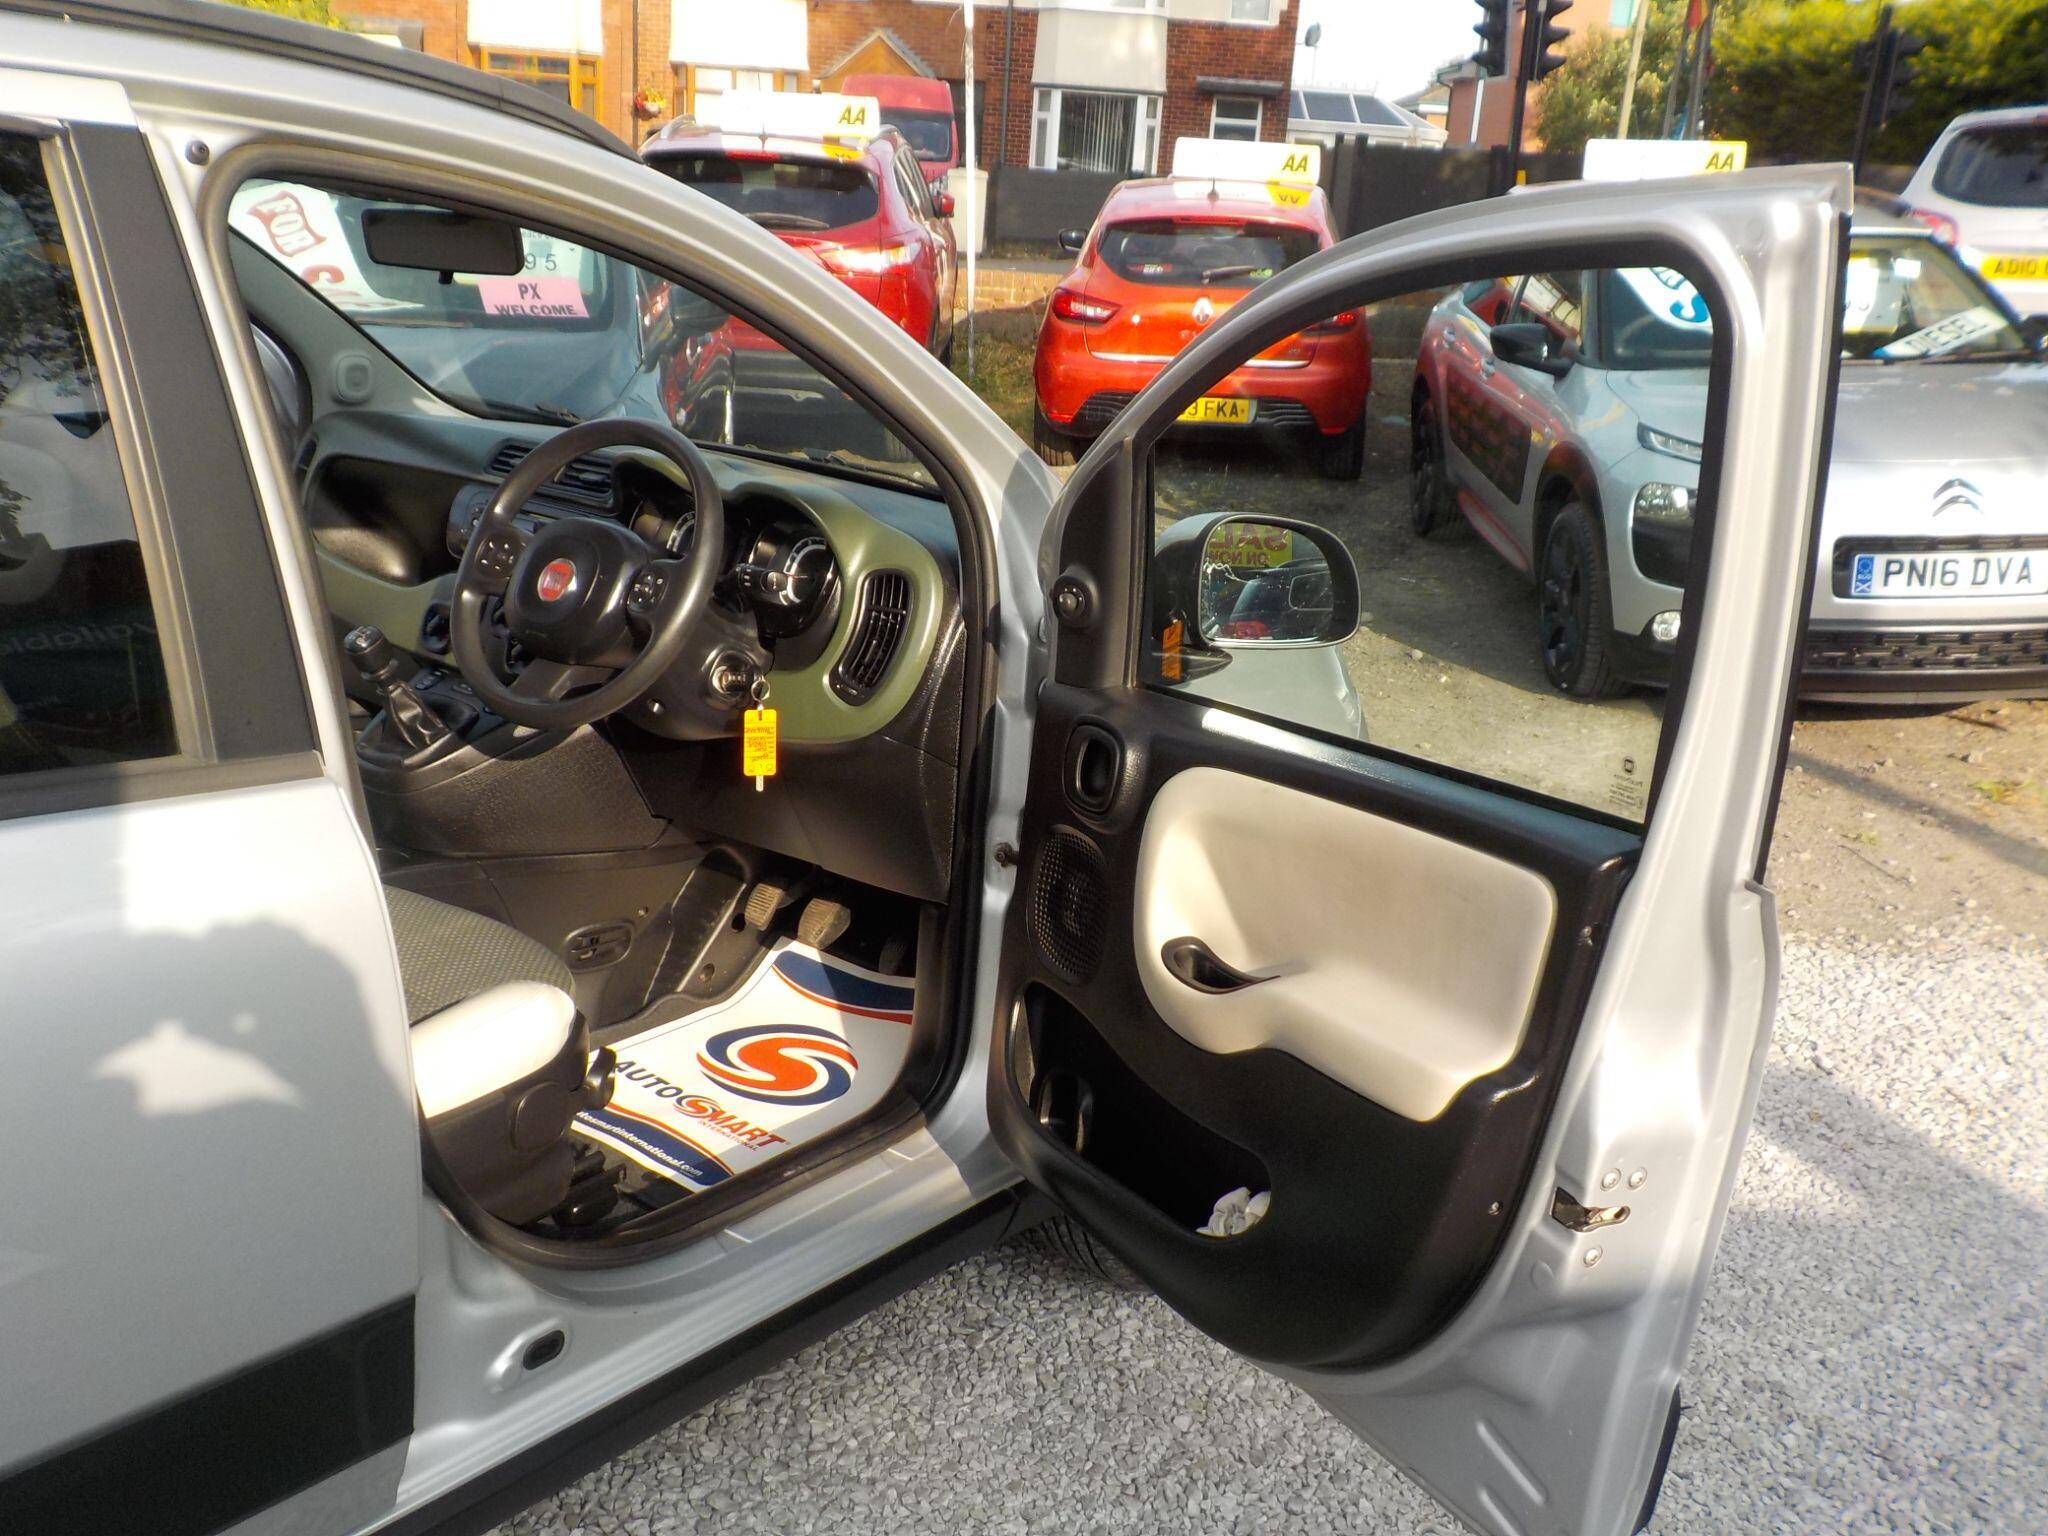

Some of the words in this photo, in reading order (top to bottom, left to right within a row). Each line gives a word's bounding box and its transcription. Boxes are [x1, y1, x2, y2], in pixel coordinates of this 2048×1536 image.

[838, 105, 867, 126] AA
[1282, 153, 1309, 173] AA
[1705, 151, 1735, 171] AA
[518, 283, 542, 300] PX
[494, 304, 578, 317] WELCOME
[1904, 315, 1989, 355] DIESEL
[1204, 400, 1240, 419] FKA
[1883, 557, 1960, 589] PN16
[1970, 555, 2033, 587] DVA
[697, 1118, 759, 1153] INTERNATIONAL
